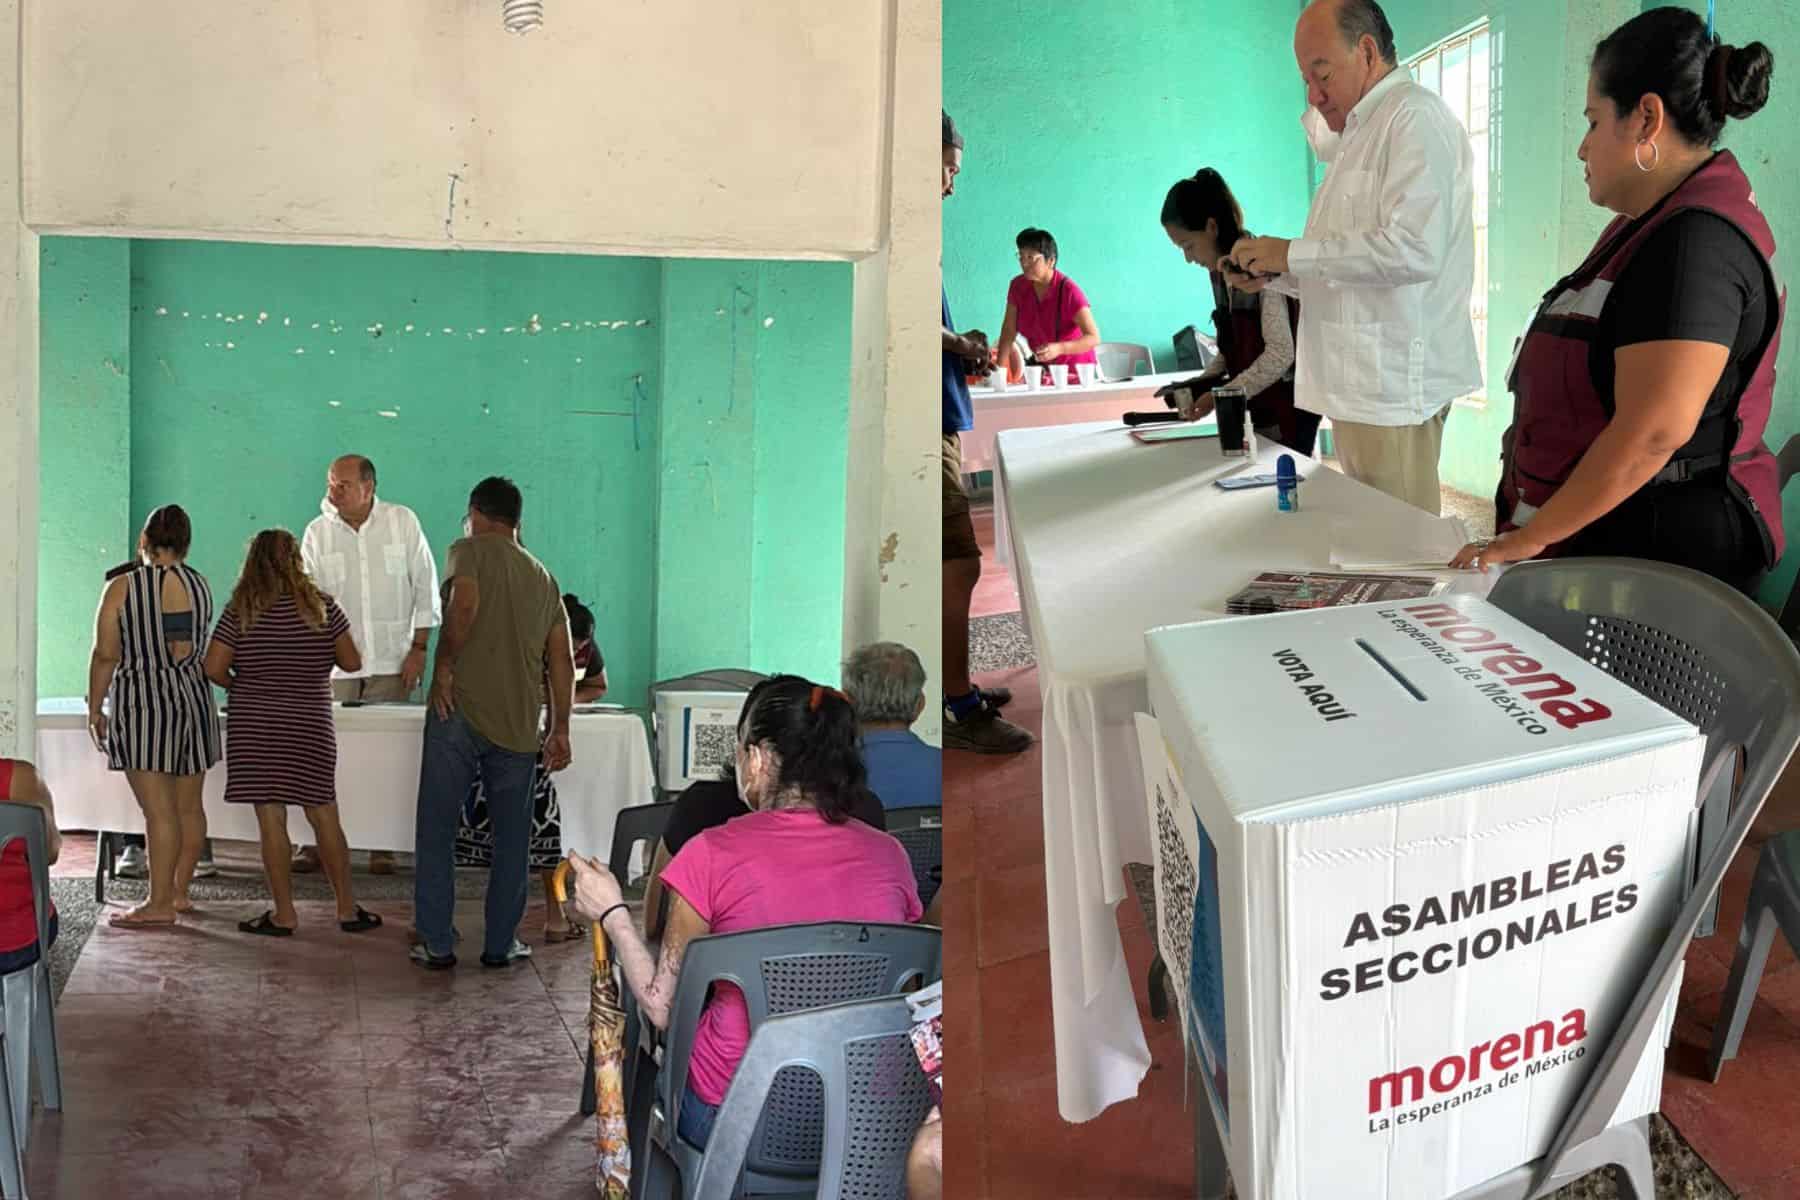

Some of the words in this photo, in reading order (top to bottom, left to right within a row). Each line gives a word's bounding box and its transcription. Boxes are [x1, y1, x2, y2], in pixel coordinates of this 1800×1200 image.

[1271, 648, 1315, 683] VOTA
[1376, 608, 1398, 618] La
[1391, 619, 1460, 664] esperanza
[1454, 666, 1482, 681] de
[1474, 682, 1548, 736] México
[1402, 603, 1612, 730] morena
[1319, 883, 1638, 1001] SECCIONALES
[1343, 844, 1626, 947] ASAMBLEAS
[1368, 1008, 1588, 1115] morena
[1368, 1116, 1390, 1134] La
[1396, 1082, 1493, 1125] esperanza
[1498, 1071, 1520, 1089] de
[1524, 1046, 1586, 1079] México
